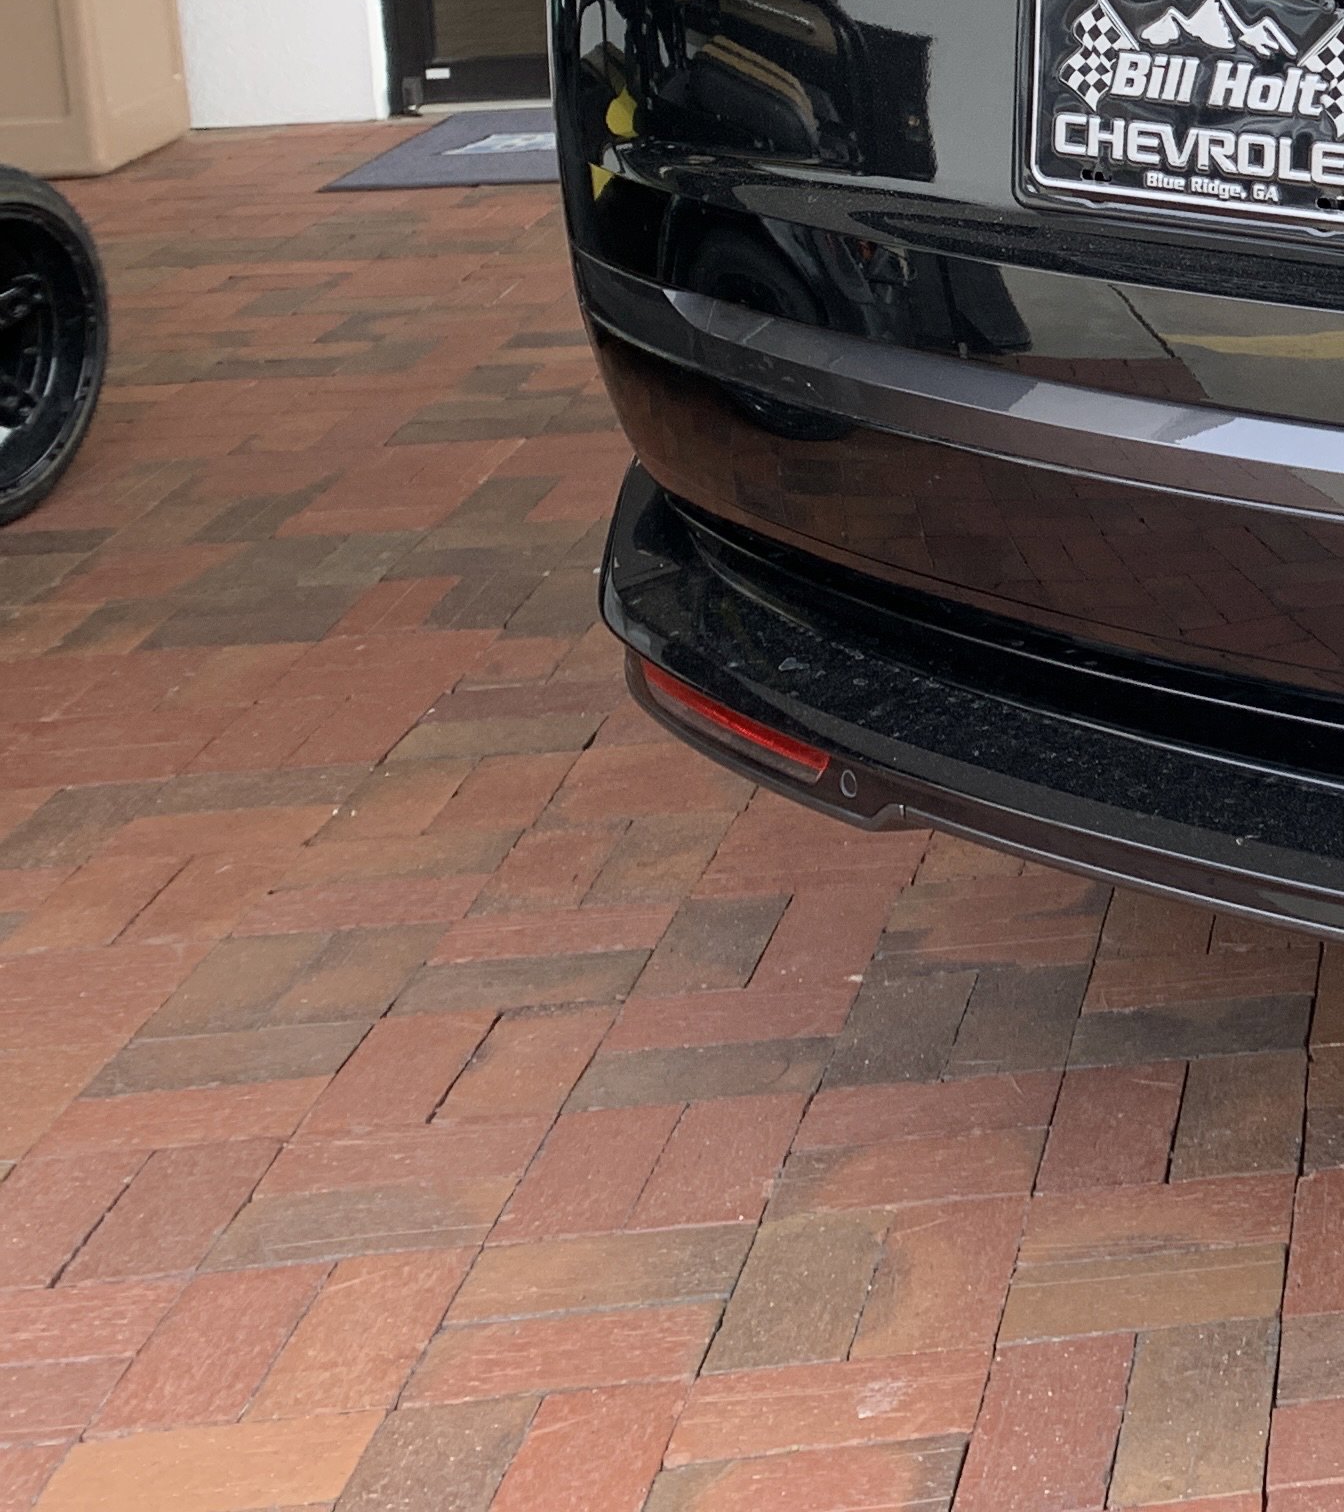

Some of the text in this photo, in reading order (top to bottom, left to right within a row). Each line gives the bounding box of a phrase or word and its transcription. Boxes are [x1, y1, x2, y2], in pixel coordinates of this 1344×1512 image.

[1110, 52, 1330, 119] Bill Holt
[1146, 171, 1280, 203] Blue Ridge, GA
